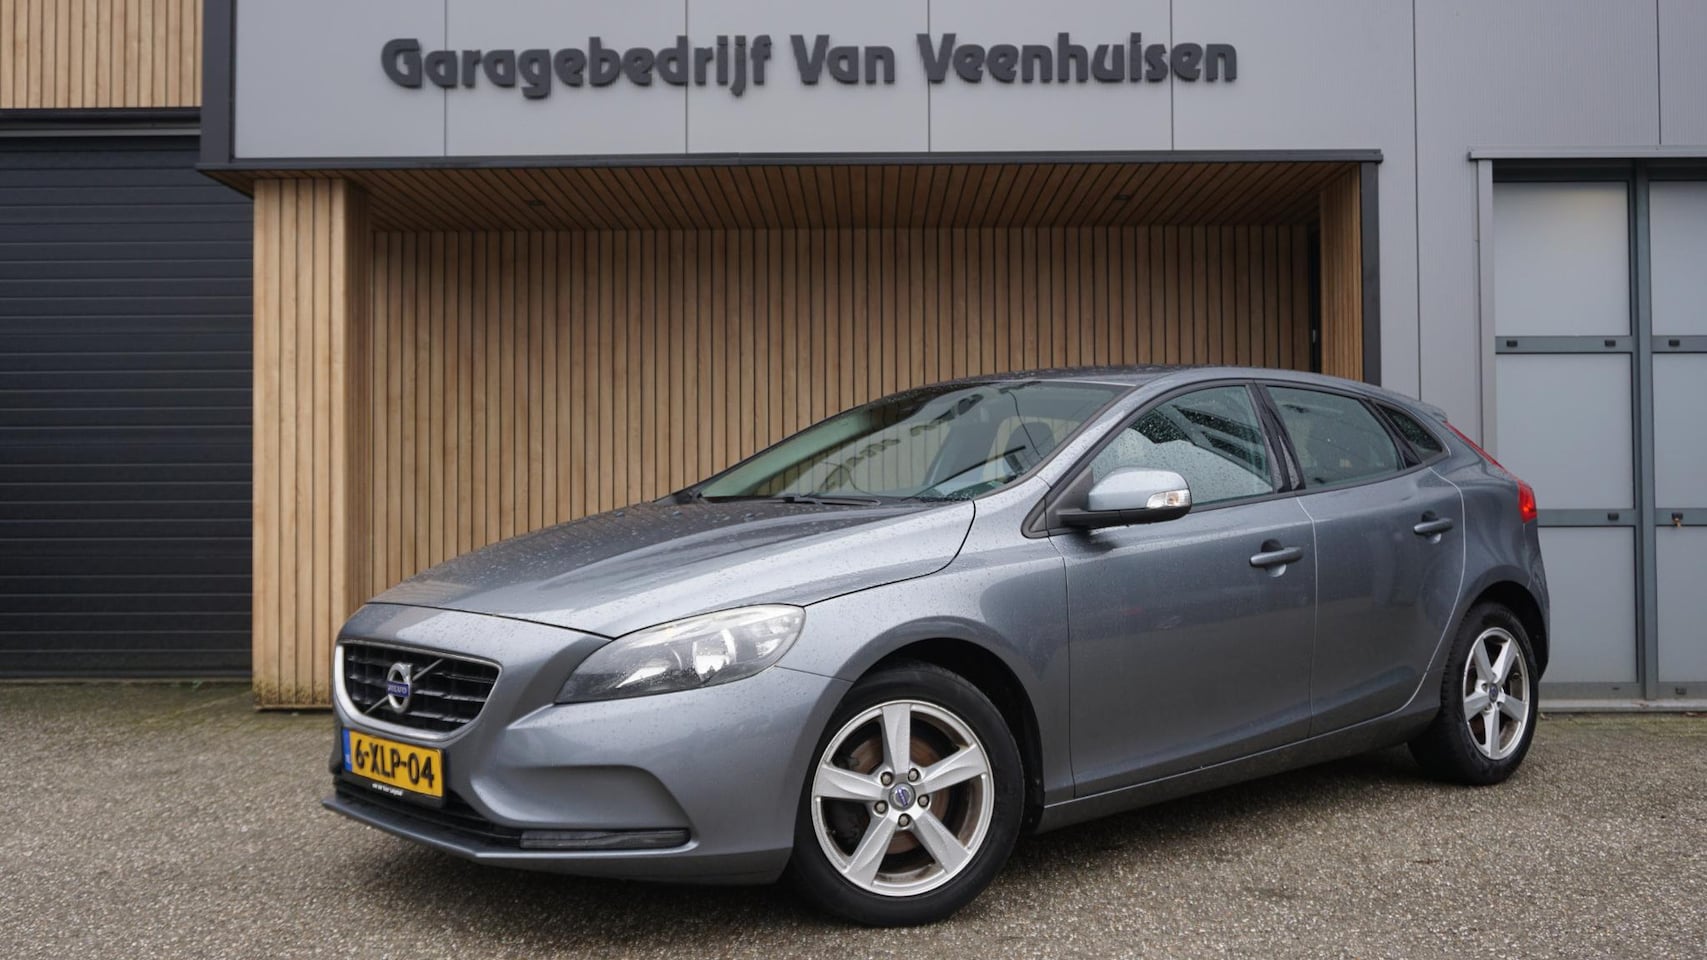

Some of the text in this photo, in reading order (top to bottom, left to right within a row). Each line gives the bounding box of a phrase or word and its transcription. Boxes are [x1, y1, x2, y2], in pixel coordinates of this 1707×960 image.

[381, 32, 1238, 99] Garagebedrijf Van Veenhuisen
[355, 739, 435, 789] 6-XLP-04
